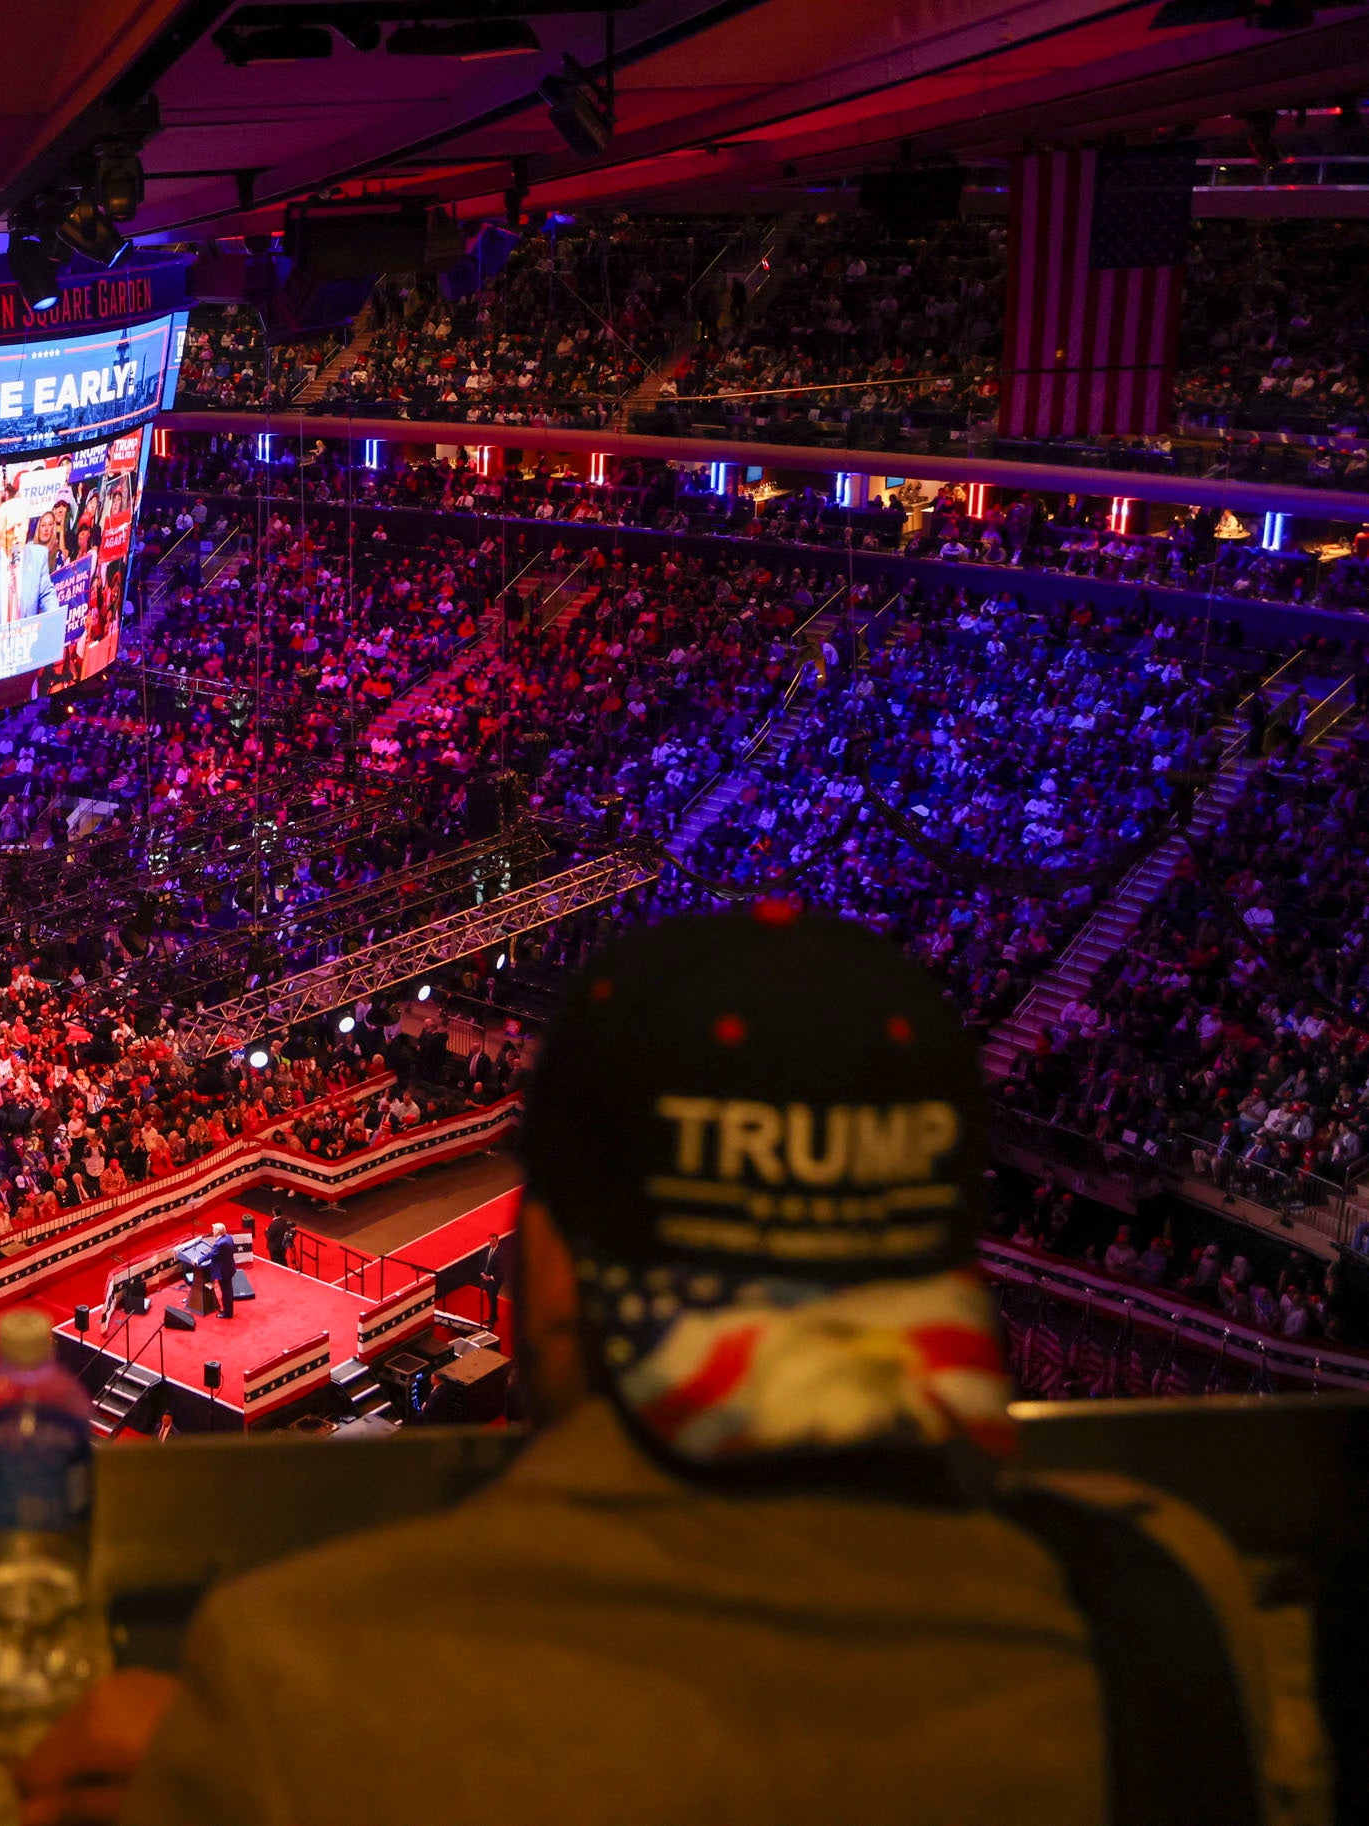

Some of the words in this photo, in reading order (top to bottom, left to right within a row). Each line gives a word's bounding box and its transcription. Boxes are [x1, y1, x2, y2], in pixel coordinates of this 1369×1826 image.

[98, 278, 152, 318] GARDEN
[34, 360, 139, 415] EARLY!
[75, 443, 108, 460] TRUMP
[115, 438, 138, 451] TRUMP
[73, 459, 88, 469] WILL
[89, 456, 99, 466] FIX
[100, 455, 106, 463] IT
[23, 483, 61, 497] TRUMP
[56, 576, 75, 590] REAM
[76, 571, 89, 583] BIG,
[57, 581, 85, 601] GAIN!
[66, 603, 88, 625] UMP
[68, 621, 79, 633] FIX
[655, 1094, 957, 1186] TRUMP
